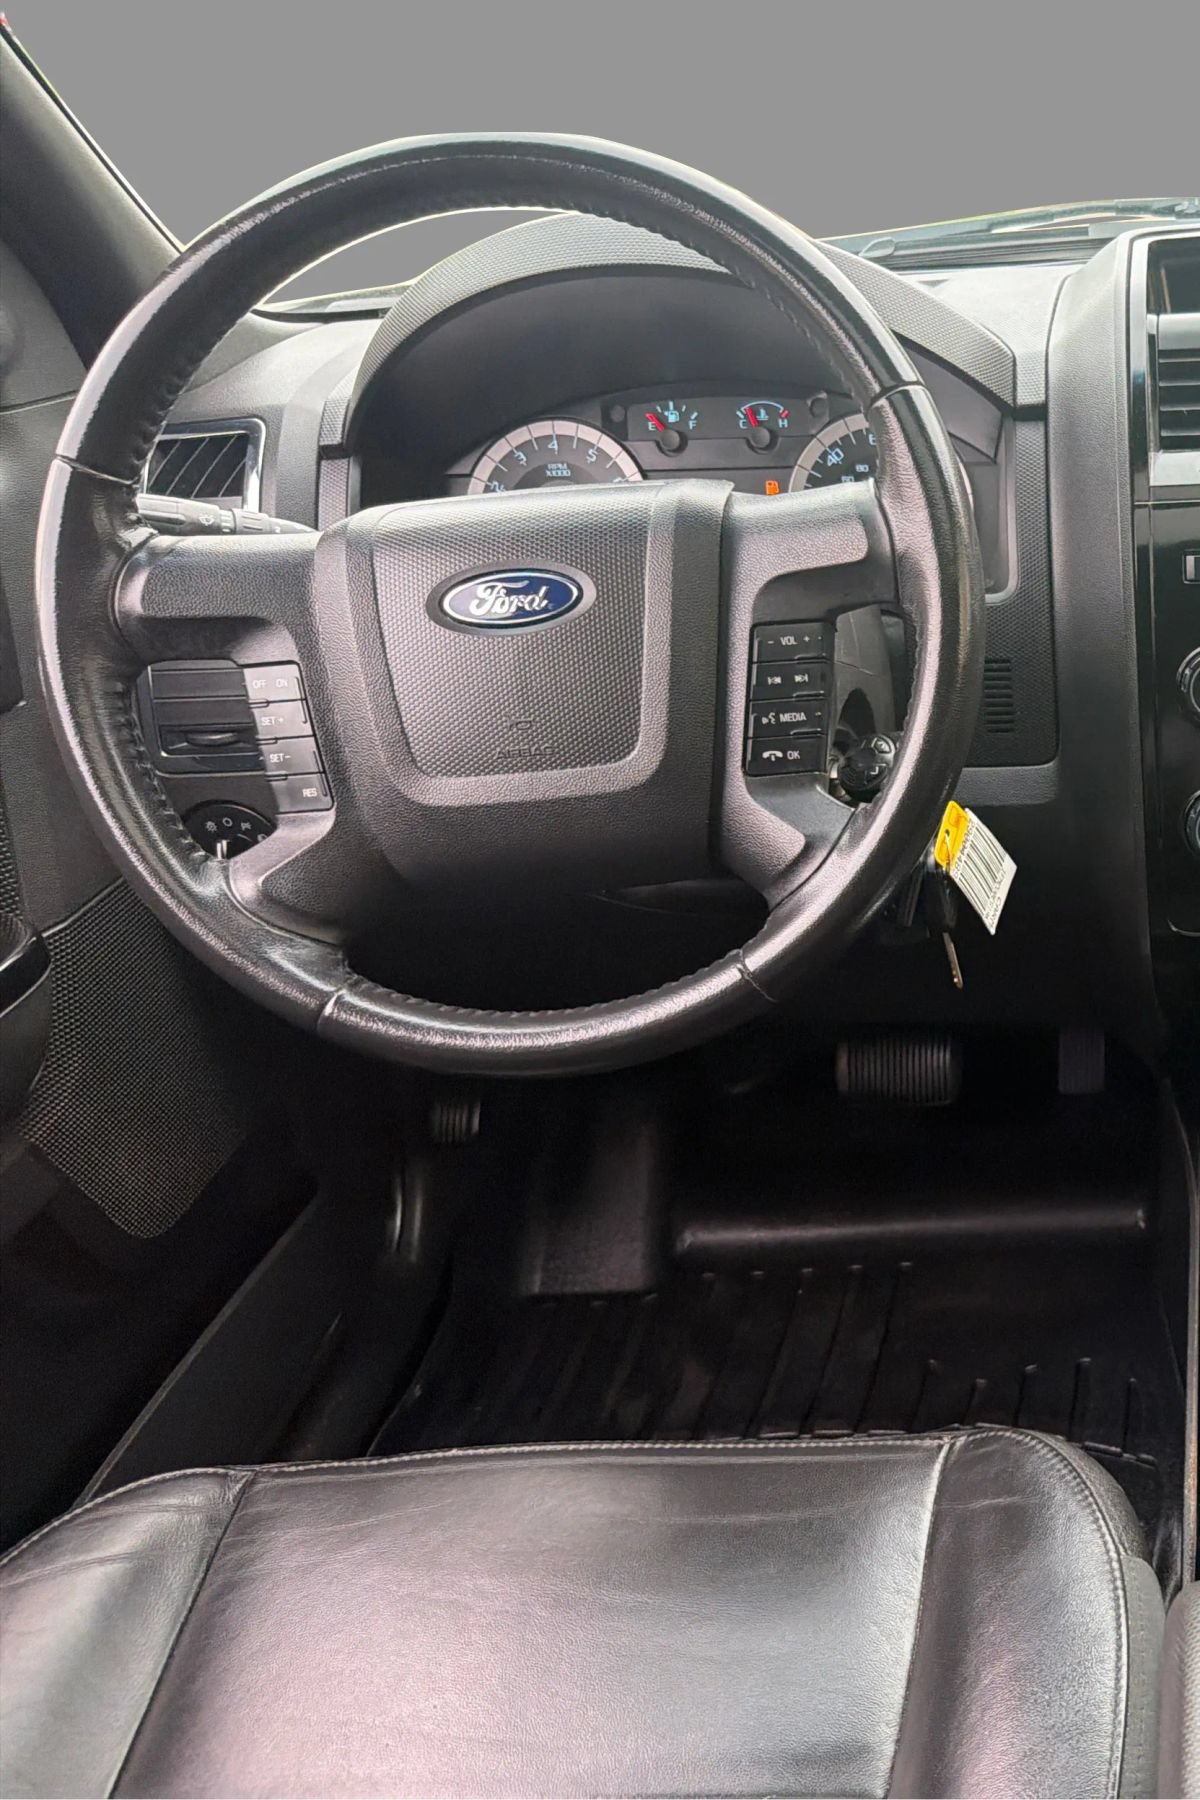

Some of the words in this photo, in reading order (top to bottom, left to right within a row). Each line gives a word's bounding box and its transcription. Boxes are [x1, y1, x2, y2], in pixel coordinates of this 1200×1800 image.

[648, 421, 656, 431] E
[689, 420, 697, 430] F
[739, 419, 748, 429] C
[778, 418, 789, 429] H
[547, 440, 559, 455] 4
[514, 451, 527, 466] 3
[585, 448, 598, 464] 5
[827, 448, 845, 467] 40
[547, 462, 568, 470] RPM
[469, 580, 549, 616] Ford
[780, 636, 798, 646] VOL
[252, 680, 267, 689] OFF
[275, 678, 288, 688] ON
[780, 712, 807, 723] MEDIA
[787, 750, 801, 760] OK
[302, 788, 318, 798] RES
